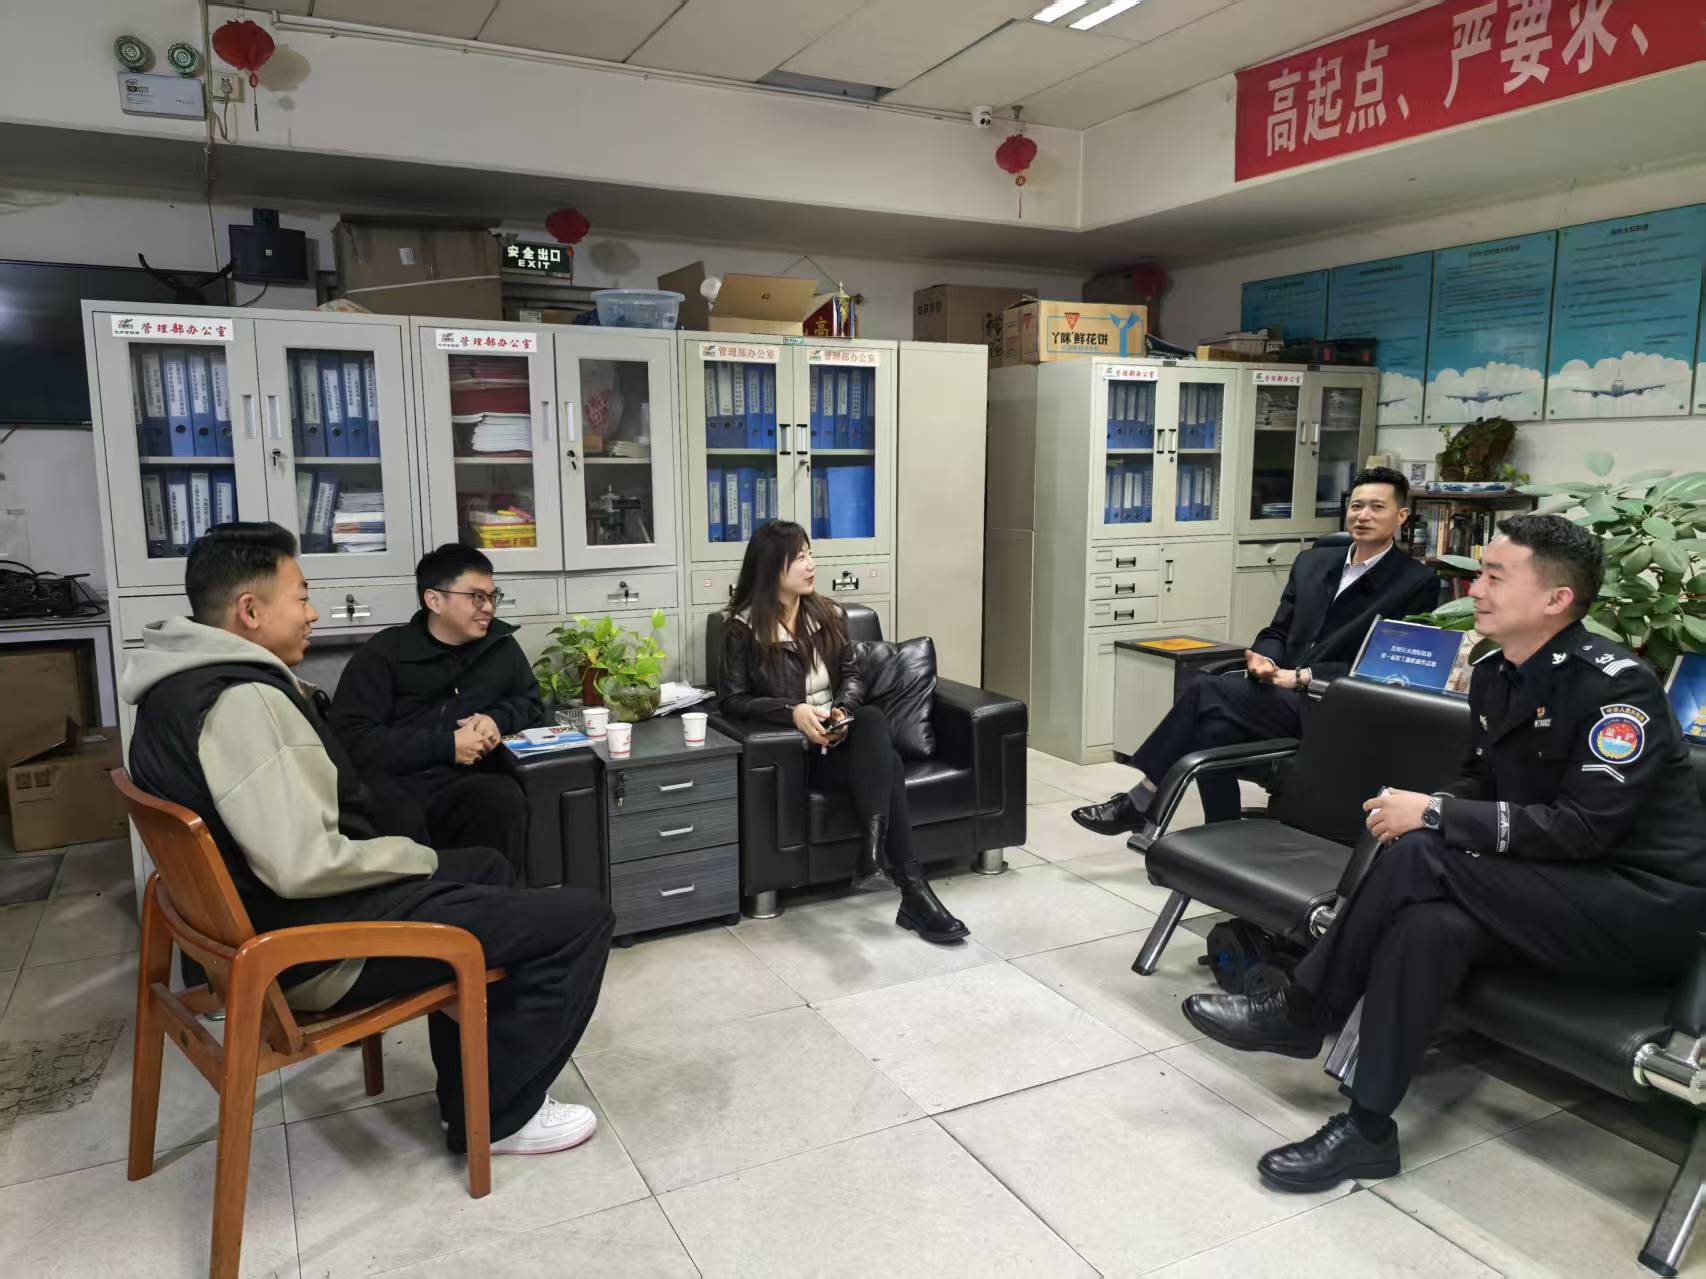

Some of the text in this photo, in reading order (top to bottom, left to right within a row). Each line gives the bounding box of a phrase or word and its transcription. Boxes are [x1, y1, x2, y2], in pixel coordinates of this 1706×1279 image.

[507, 244, 560, 262] 安全出口
[518, 259, 550, 269] EXIT
[142, 322, 227, 337] 管理部办公室
[461, 335, 532, 349] 管理部办公室
[718, 345, 776, 360] 管理部办公室
[823, 350, 877, 364] 管理部办公室
